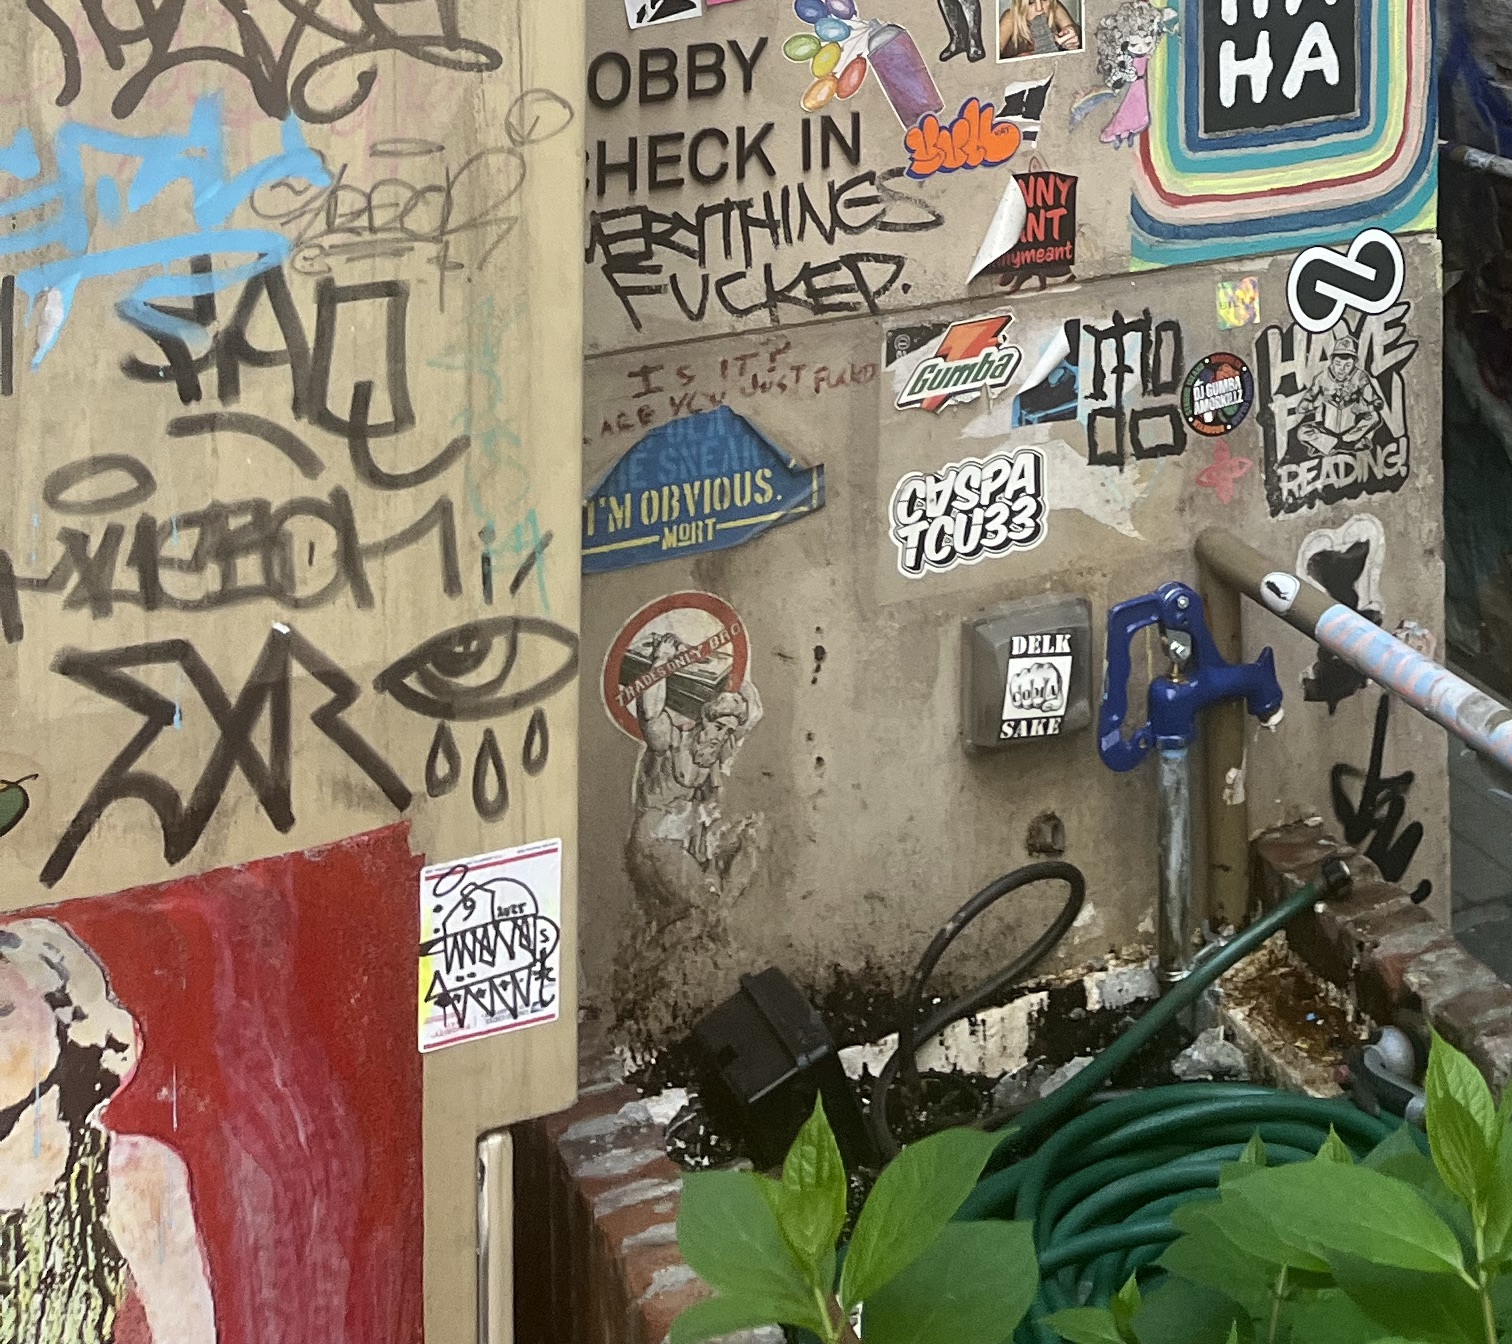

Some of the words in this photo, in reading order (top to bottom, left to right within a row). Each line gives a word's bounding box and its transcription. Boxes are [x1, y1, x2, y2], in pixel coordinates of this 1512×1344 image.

[588, 37, 768, 109] OBBY
[1218, 20, 1341, 109] HA
[585, 122, 776, 197] HECK
[801, 111, 861, 172] IN
[907, 351, 1016, 397] Gumba
[1205, 375, 1243, 397] GUMBA
[1268, 370, 1406, 463] FN
[640, 467, 784, 527] OBVIOUS.
[1277, 435, 1409, 503] READING!
[661, 517, 717, 551] MORT
[615, 666, 668, 707] TRADES
[667, 644, 702, 675] ONLY
[709, 622, 741, 652] BRO
[1011, 633, 1072, 656] DELK
[999, 717, 1062, 740] SAKE
